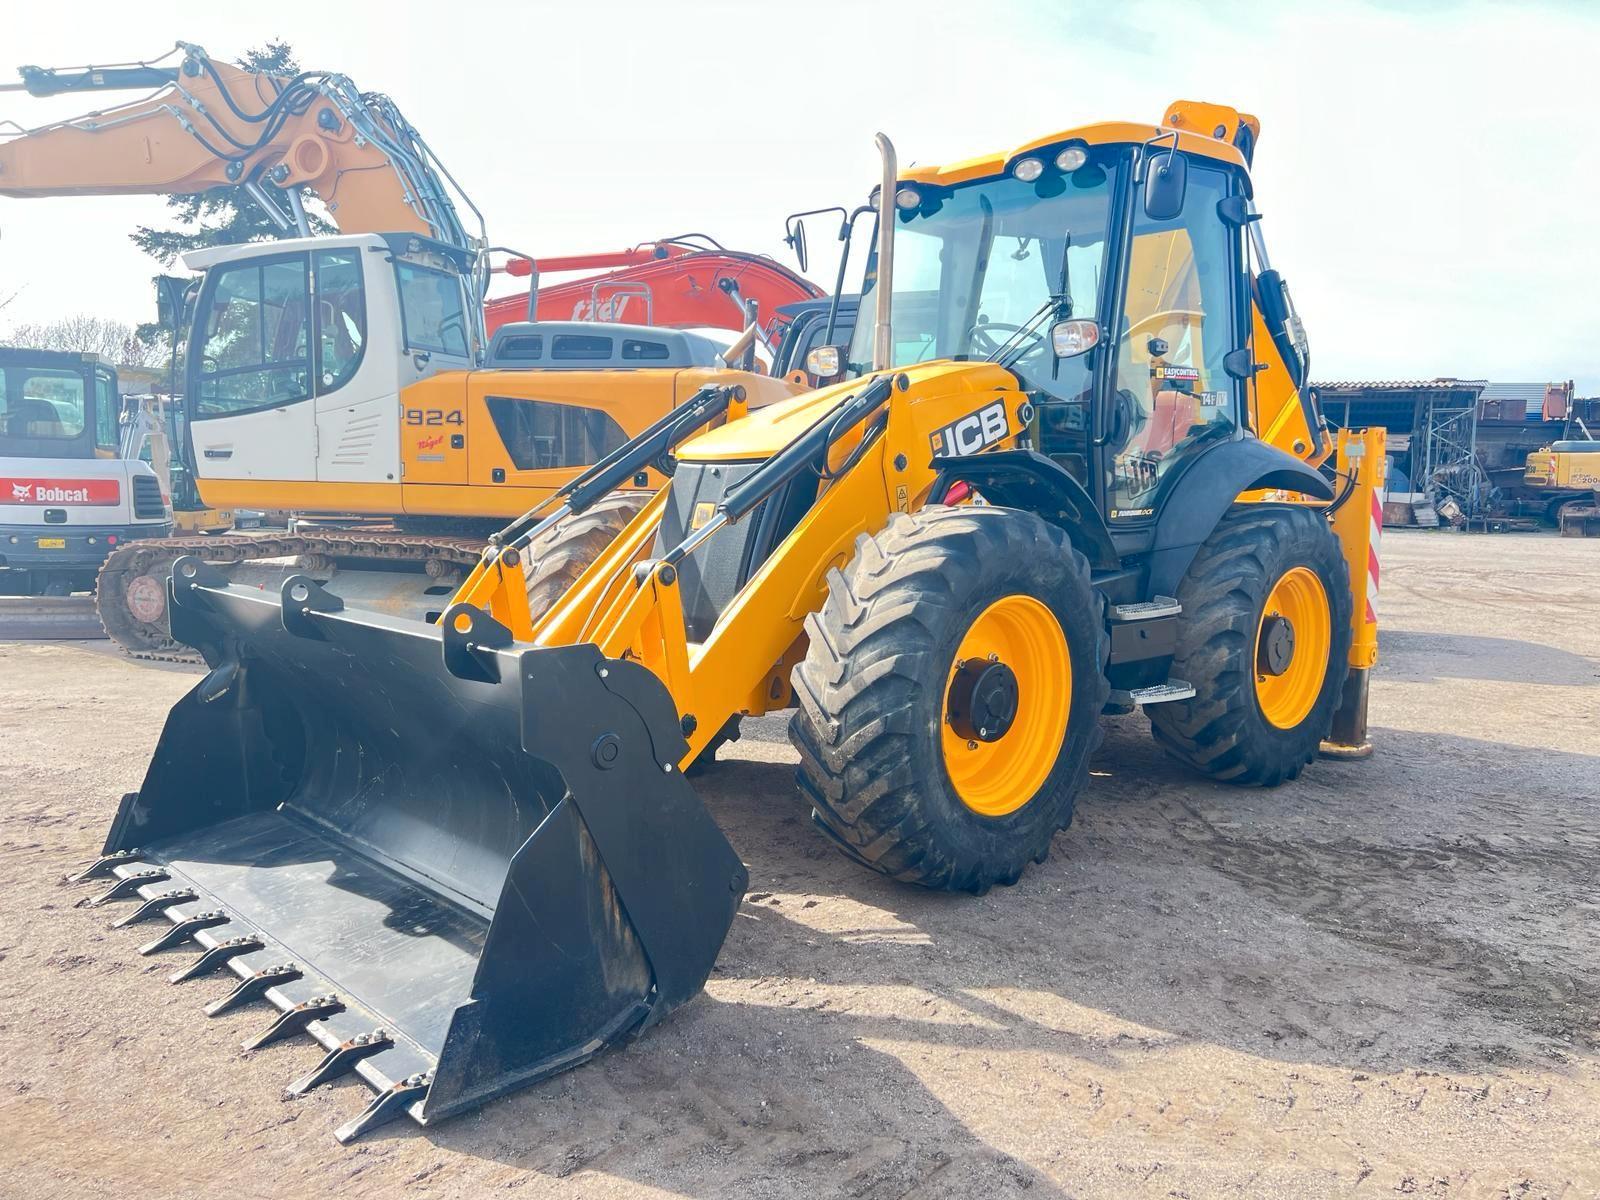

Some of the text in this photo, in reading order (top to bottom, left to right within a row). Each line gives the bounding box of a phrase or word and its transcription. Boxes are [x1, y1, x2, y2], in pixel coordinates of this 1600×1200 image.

[407, 409, 464, 426] 924
[935, 403, 1008, 458] JCB
[36, 486, 88, 502] Bobcat
